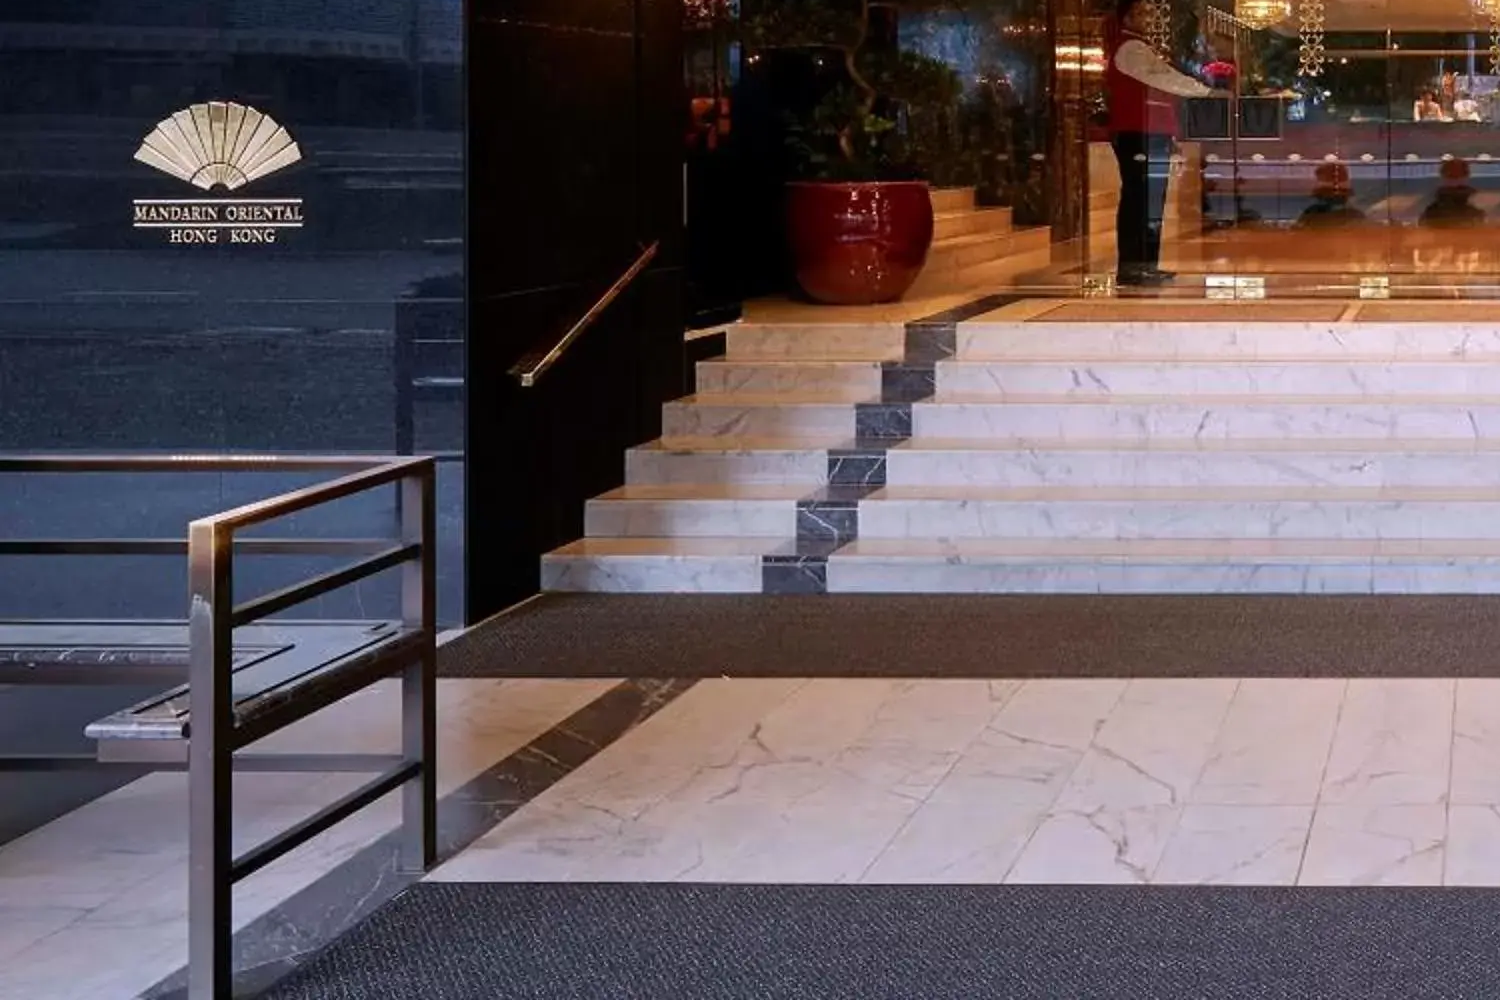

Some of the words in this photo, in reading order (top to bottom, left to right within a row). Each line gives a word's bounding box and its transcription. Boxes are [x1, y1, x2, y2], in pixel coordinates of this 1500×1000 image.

[134, 206, 218, 221] MANDARIN
[225, 206, 303, 221] ORIENTAL
[170, 229, 217, 243] HONG
[231, 229, 276, 243] KONG
